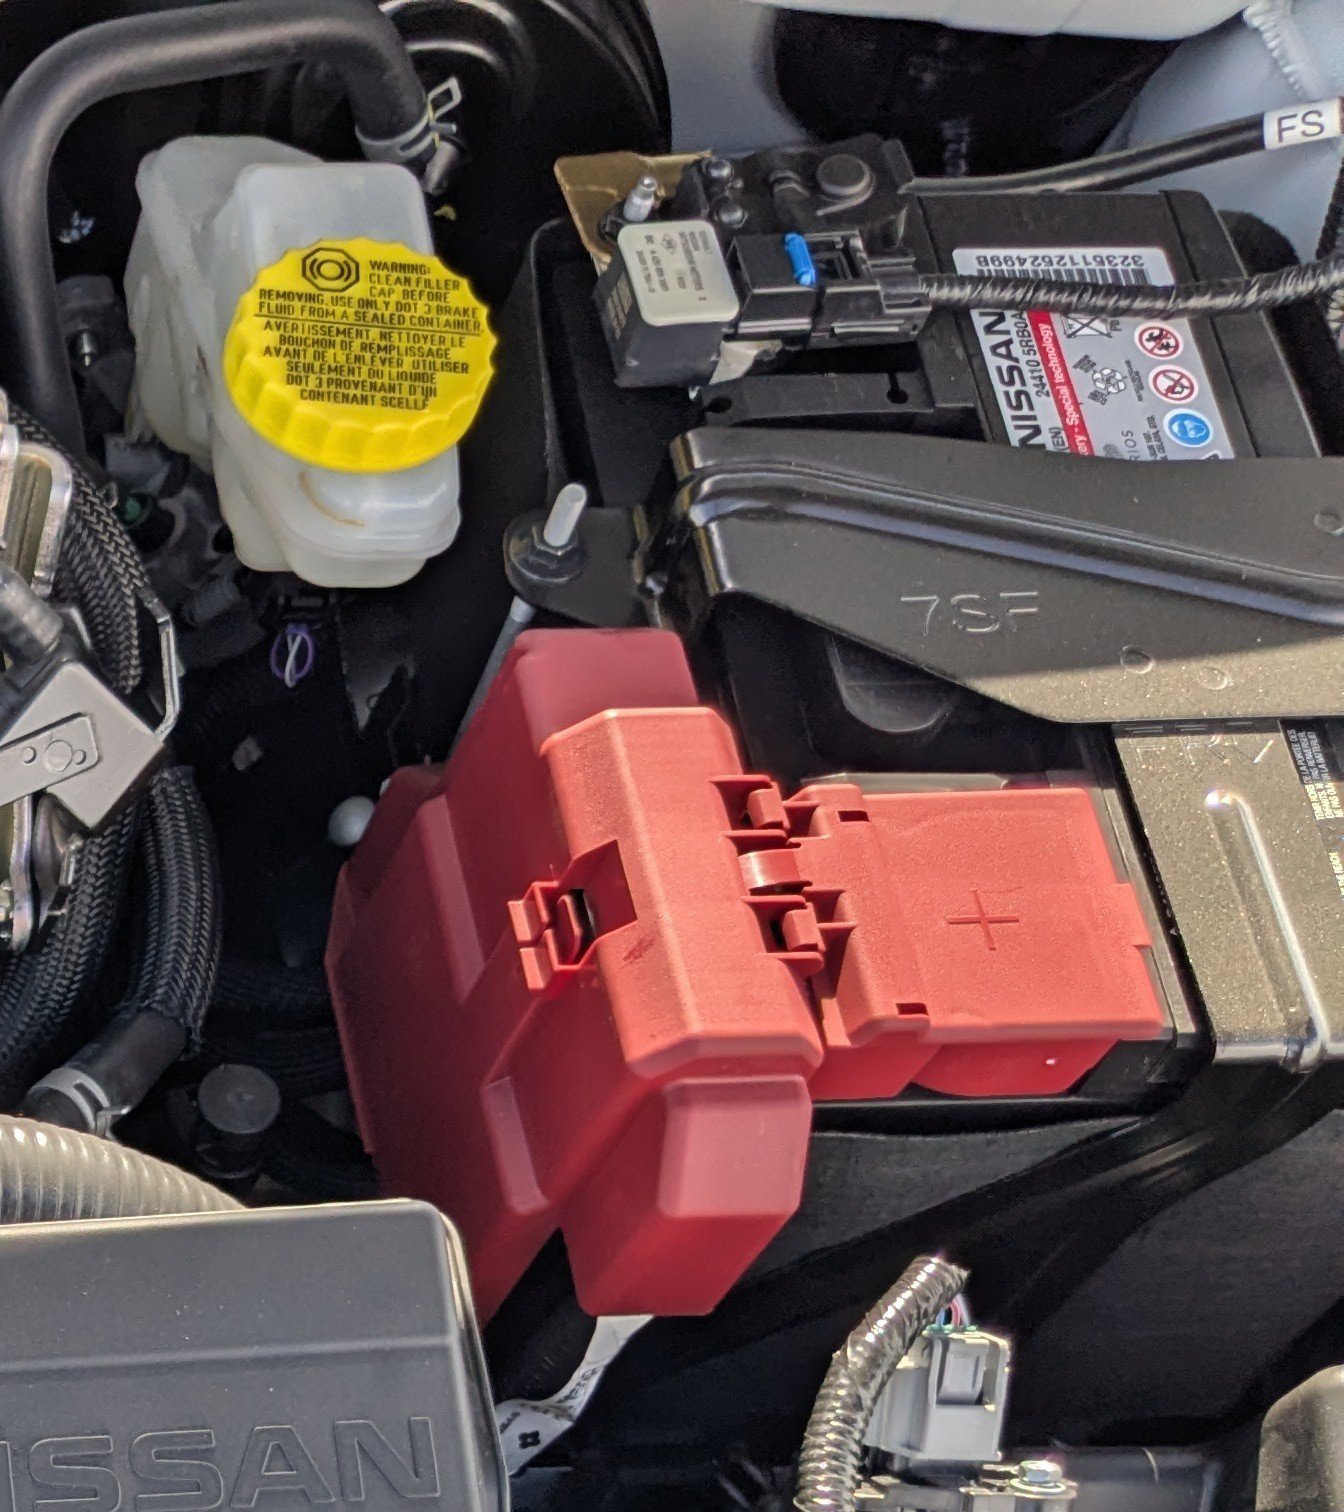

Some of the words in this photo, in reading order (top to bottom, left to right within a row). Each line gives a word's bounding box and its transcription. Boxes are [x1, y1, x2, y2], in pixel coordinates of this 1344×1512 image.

[1277, 110, 1326, 143] FS
[369, 260, 431, 276] WARNING:
[369, 274, 413, 287] CLEAN
[415, 277, 460, 290] FILLER
[369, 286, 395, 298] CAP
[402, 289, 449, 303] BEFORE
[258, 301, 295, 316] FLUID
[300, 305, 336, 320] FROM
[340, 309, 349, 320] A
[353, 310, 405, 327] SEALED
[331, 296, 354, 308] USE
[357, 298, 390, 311] ONLY
[395, 301, 418, 314] DOT
[424, 303, 432, 314] 3
[435, 305, 479, 319] BRAKE
[279, 334, 336, 350] BOUCHON
[340, 339, 355, 351] DE
[359, 341, 451, 360] REMPLISSAGE
[379, 328, 446, 346] NETTOYER
[450, 336, 466, 348] LE
[263, 346, 310, 362] AVANT
[313, 351, 329, 363] DE
[411, 361, 469, 374] UTILISER
[1039, 322, 1065, 384] technology
[286, 360, 362, 378] SEULEMENT
[367, 368, 384, 380] DU
[388, 369, 436, 384] LIQUIDE
[286, 374, 310, 387] DOT
[315, 375, 323, 387] 3
[326, 378, 403, 395] PROVENANT
[979, 311, 1047, 449] NISSAN
[1025, 360, 1050, 398] 24410
[300, 390, 376, 407] CONTENANT
[1055, 385, 1079, 427] Special
[900, 590, 1040, 636] 7SF
